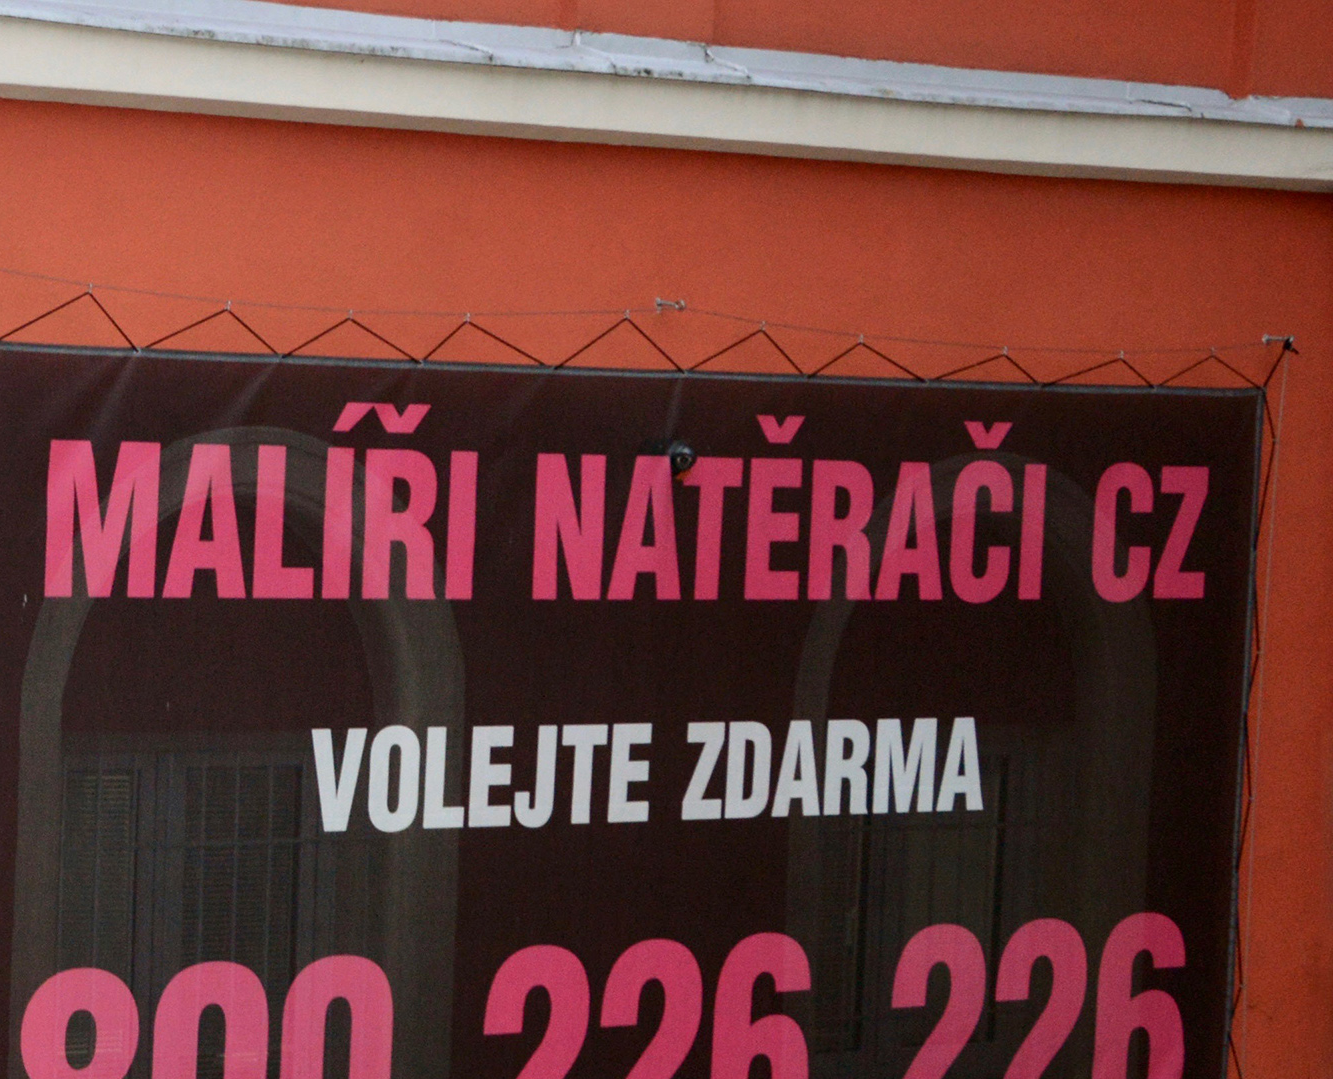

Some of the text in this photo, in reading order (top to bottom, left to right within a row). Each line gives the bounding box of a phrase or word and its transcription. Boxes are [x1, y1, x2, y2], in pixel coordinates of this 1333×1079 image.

[44, 401, 1209, 604] MALÍŘI NATĚRAČI CZ
[311, 717, 983, 833] VOLEJTE ZDARMA
